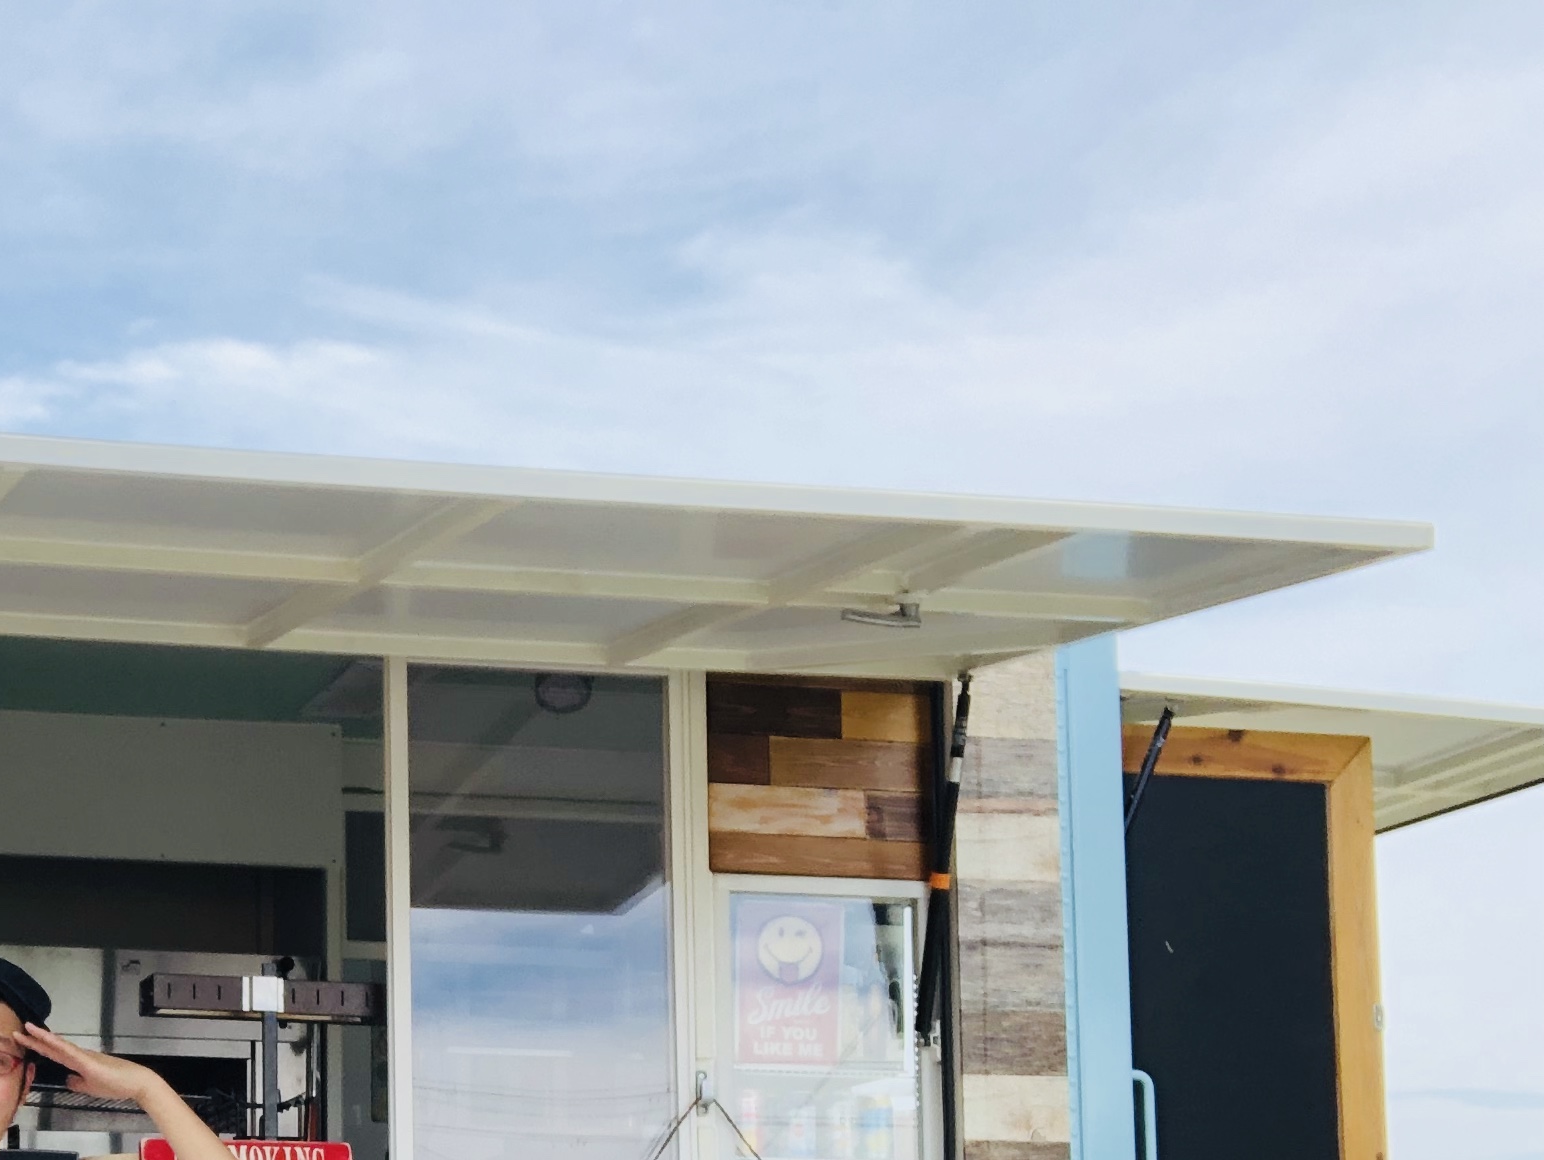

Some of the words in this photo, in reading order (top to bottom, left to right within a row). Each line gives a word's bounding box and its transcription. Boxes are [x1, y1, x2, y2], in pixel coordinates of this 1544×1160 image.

[748, 982, 830, 1025] Smile
[760, 1025, 776, 1040] IF
[782, 1025, 818, 1041] YOU
[754, 1041, 793, 1056] LIKE
[798, 1042, 823, 1057] ME
